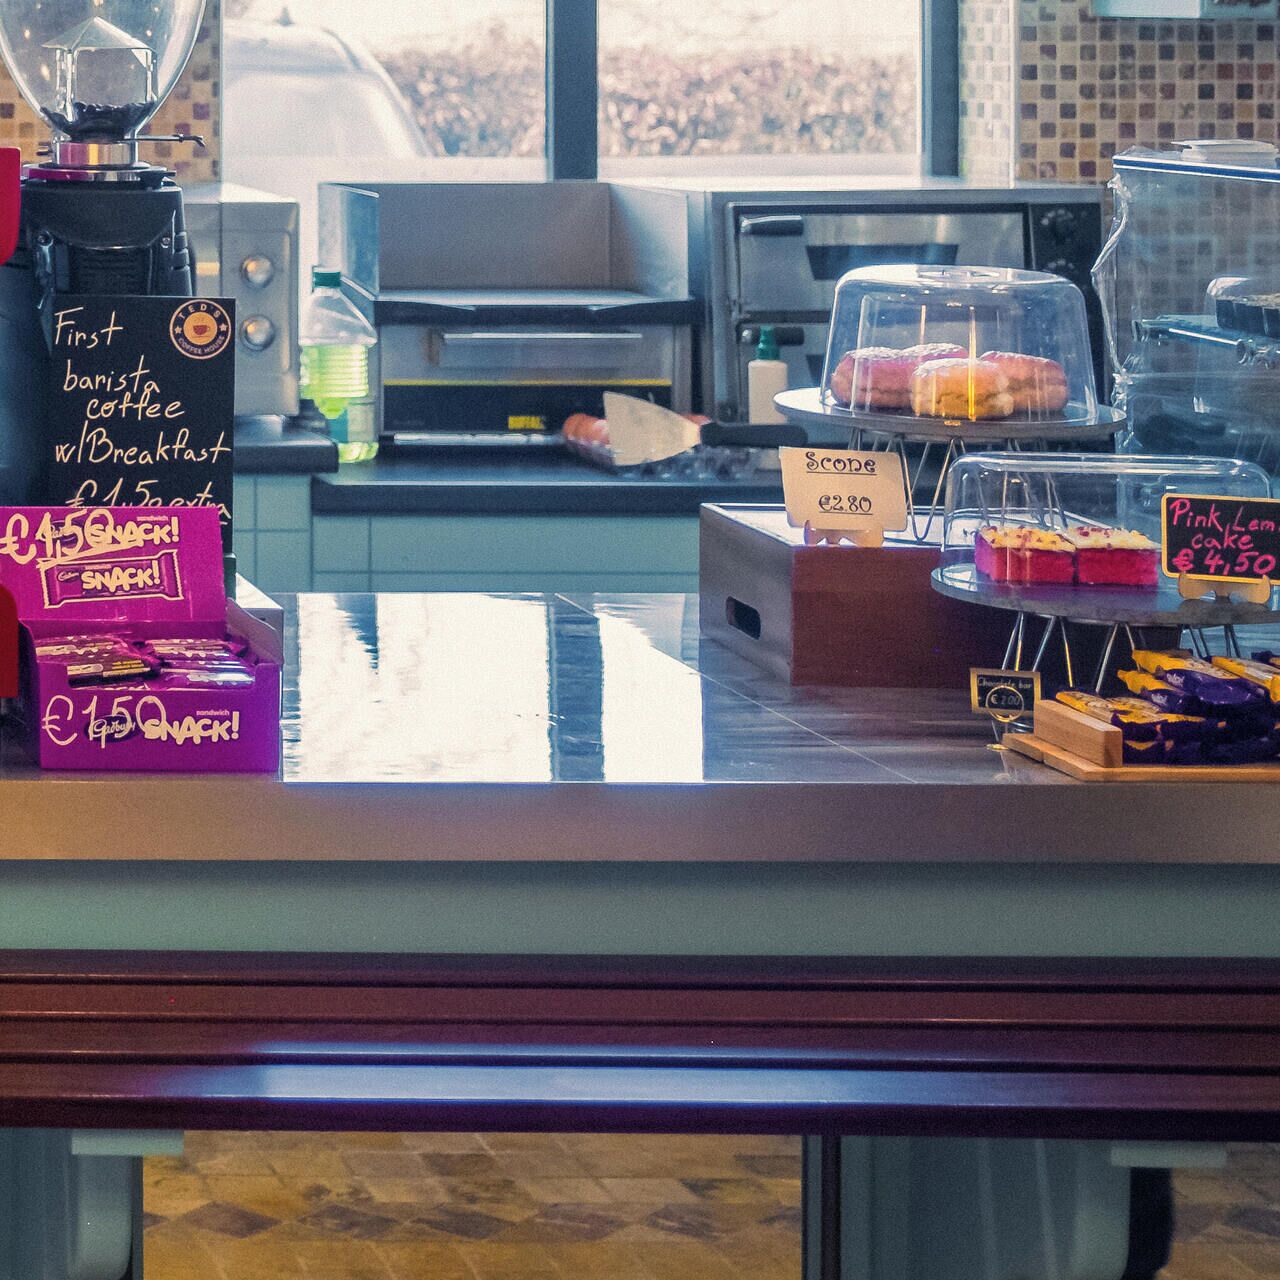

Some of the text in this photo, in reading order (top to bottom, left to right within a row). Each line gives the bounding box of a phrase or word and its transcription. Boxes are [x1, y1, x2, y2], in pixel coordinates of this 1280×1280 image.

[54, 307, 124, 347] First
[63, 355, 161, 395] barista
[86, 393, 186, 421] coffee
[805, 451, 876, 473] Scone
[818, 494, 872, 513] €2.80
[1169, 498, 1223, 532] Pink
[81, 560, 161, 593] SNACK!
[142, 711, 240, 744] SNACK!
